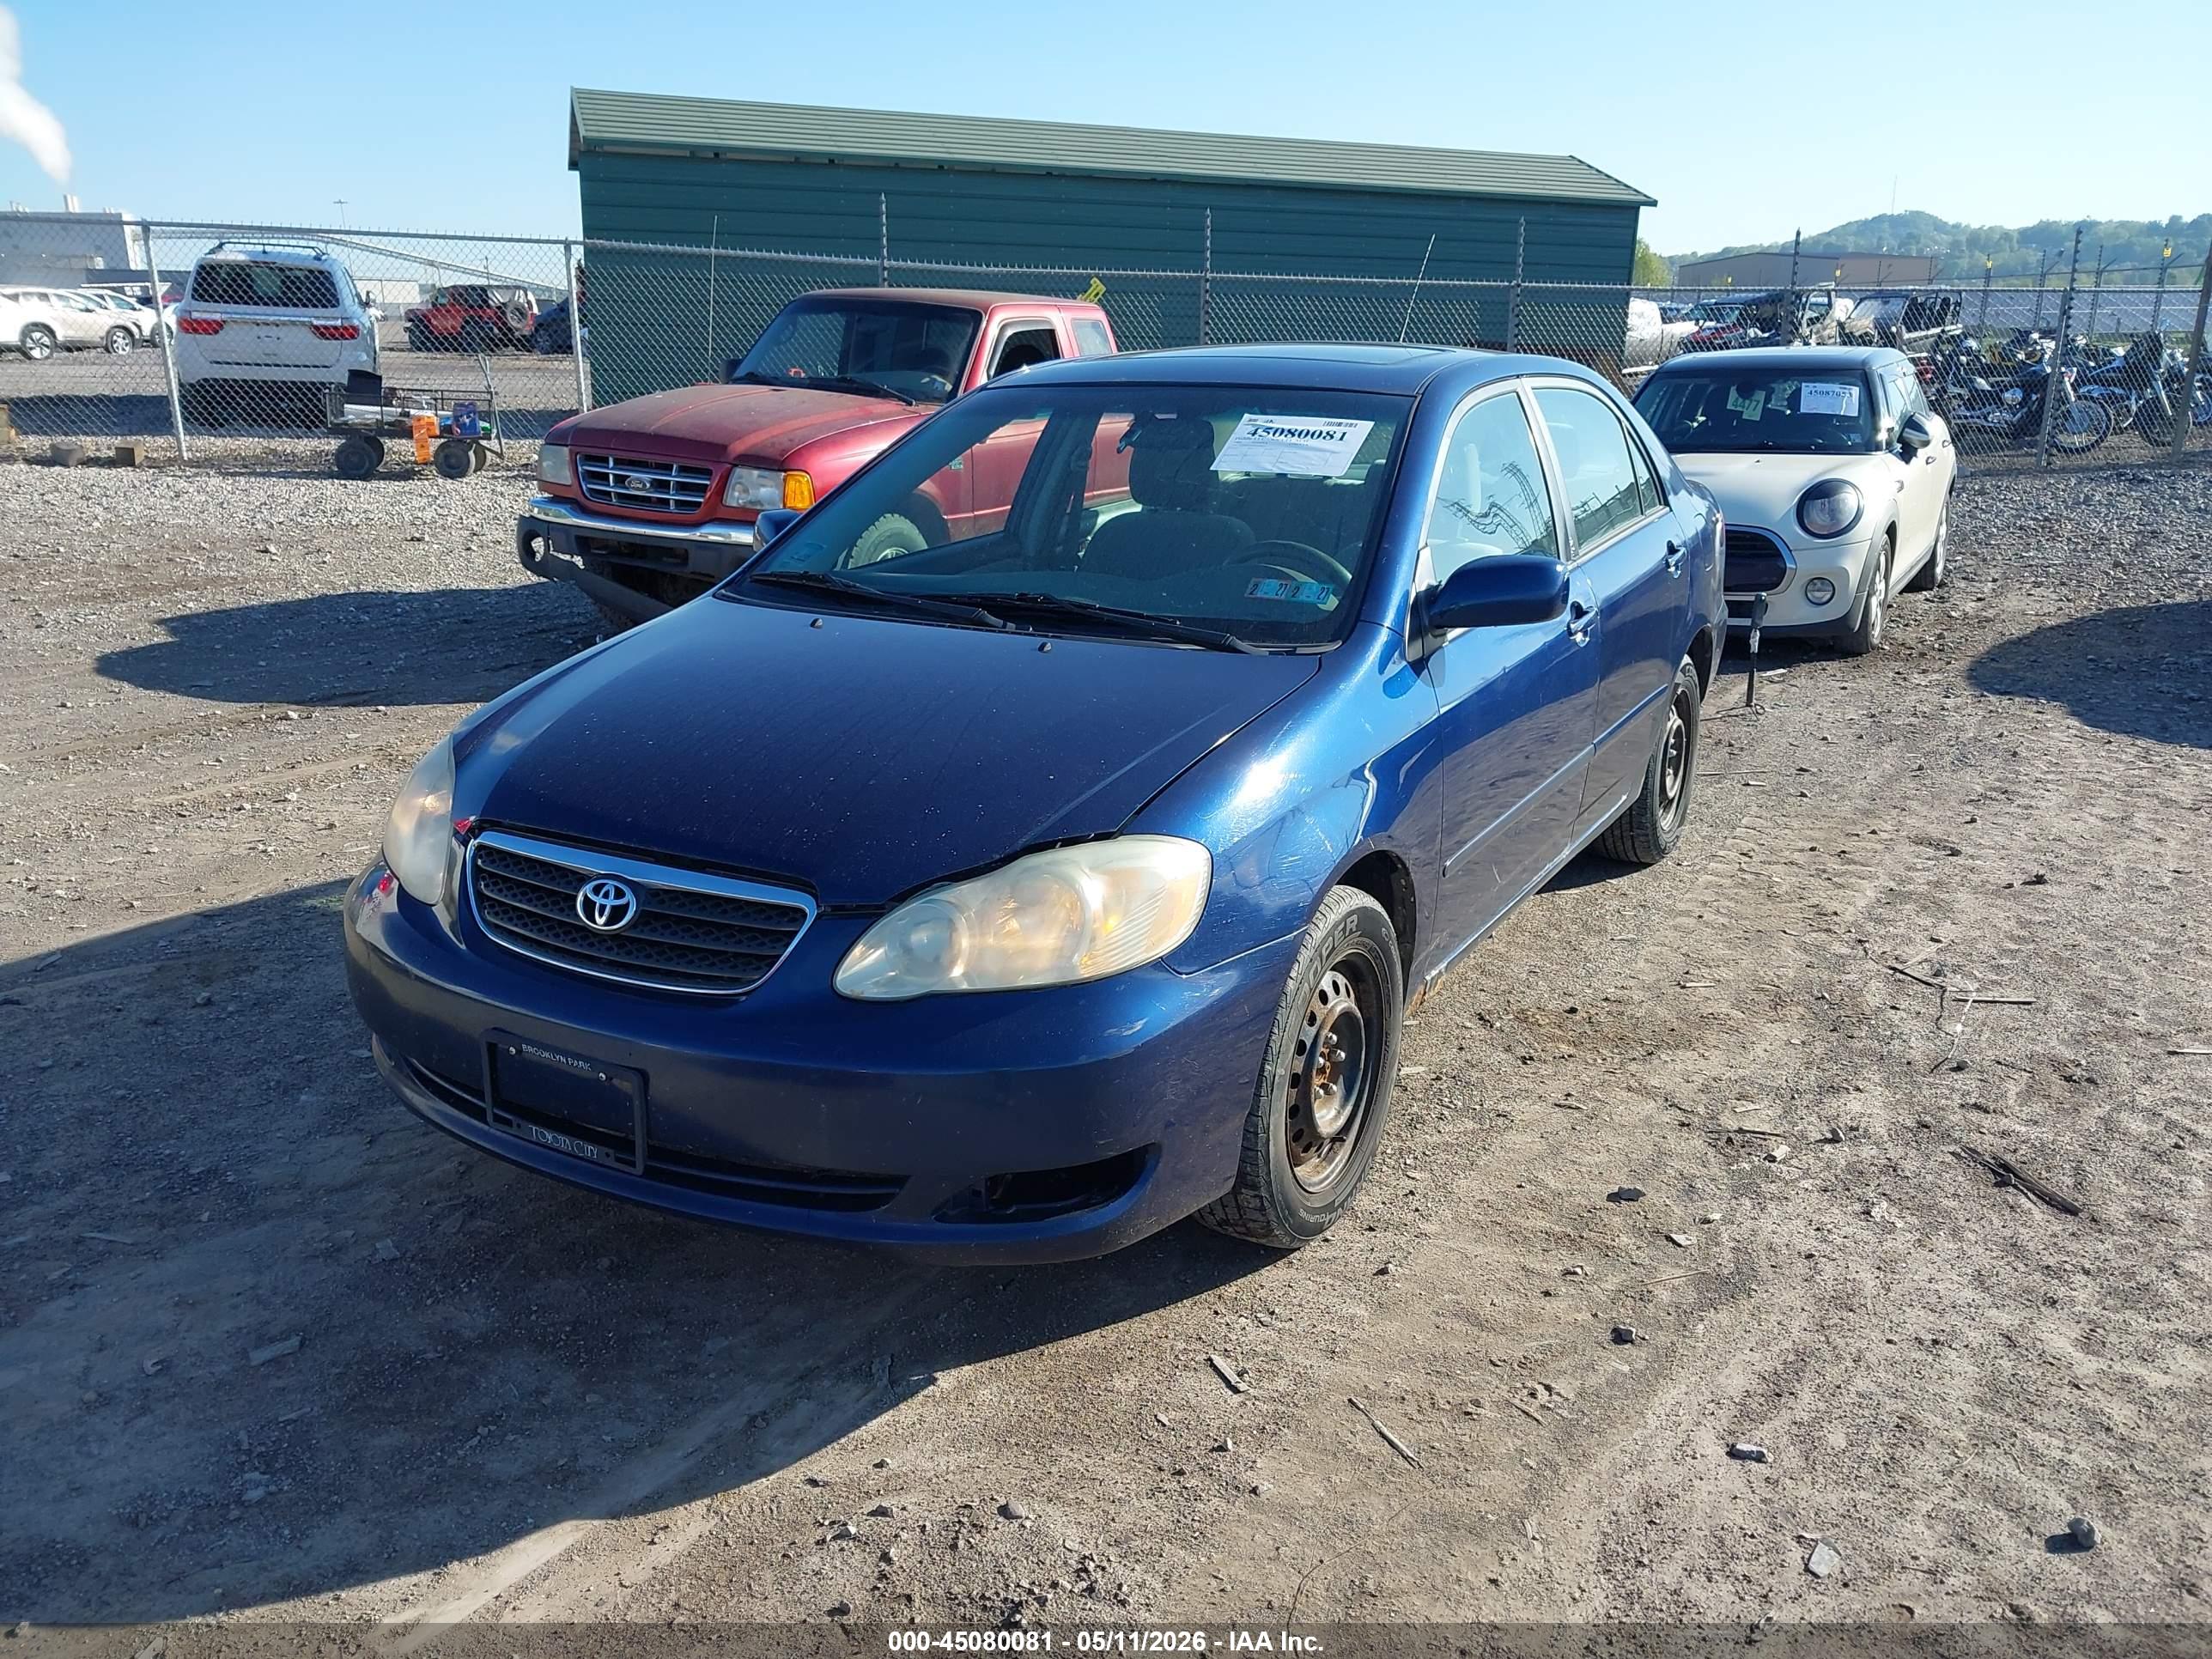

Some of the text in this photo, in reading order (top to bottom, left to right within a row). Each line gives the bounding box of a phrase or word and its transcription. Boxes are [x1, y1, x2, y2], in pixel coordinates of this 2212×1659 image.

[1246, 426, 1348, 442] 45080081
[1249, 582, 1289, 598] 2 27
[1291, 586, 1330, 600] 2 27
[521, 1043, 592, 1072] BROOKLYN PARK
[528, 1125, 572, 1151] TOYOTA
[1297, 1208, 1327, 1224] TOURING
